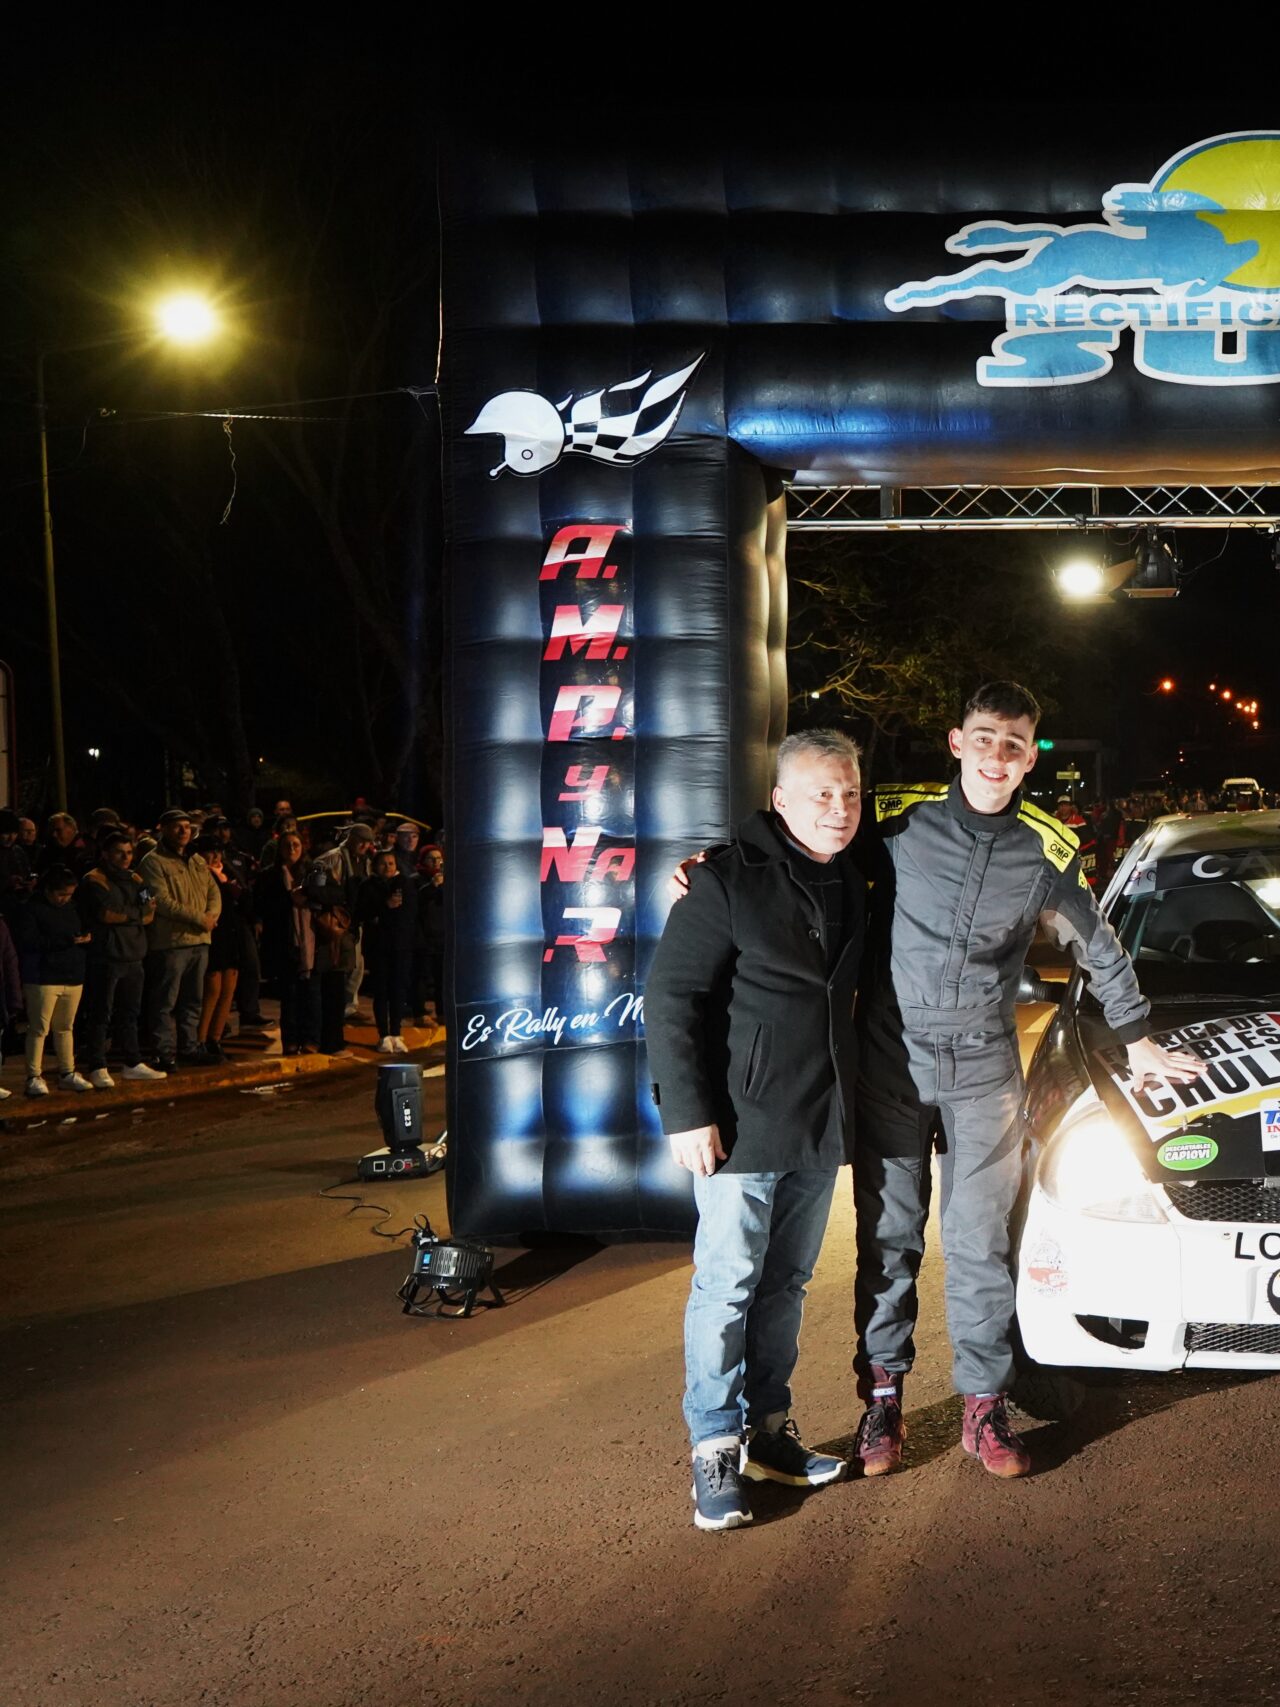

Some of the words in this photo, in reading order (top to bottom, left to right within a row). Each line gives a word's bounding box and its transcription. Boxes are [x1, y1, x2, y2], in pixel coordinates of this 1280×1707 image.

[879, 799, 903, 811] OMP
[1049, 842, 1069, 860] OMP
[462, 1014, 494, 1050] Es
[496, 1006, 567, 1045] Rally
[570, 1012, 601, 1029] en
[1226, 1013, 1272, 1031] DE
[1164, 1150, 1210, 1161] CAPIOVI
